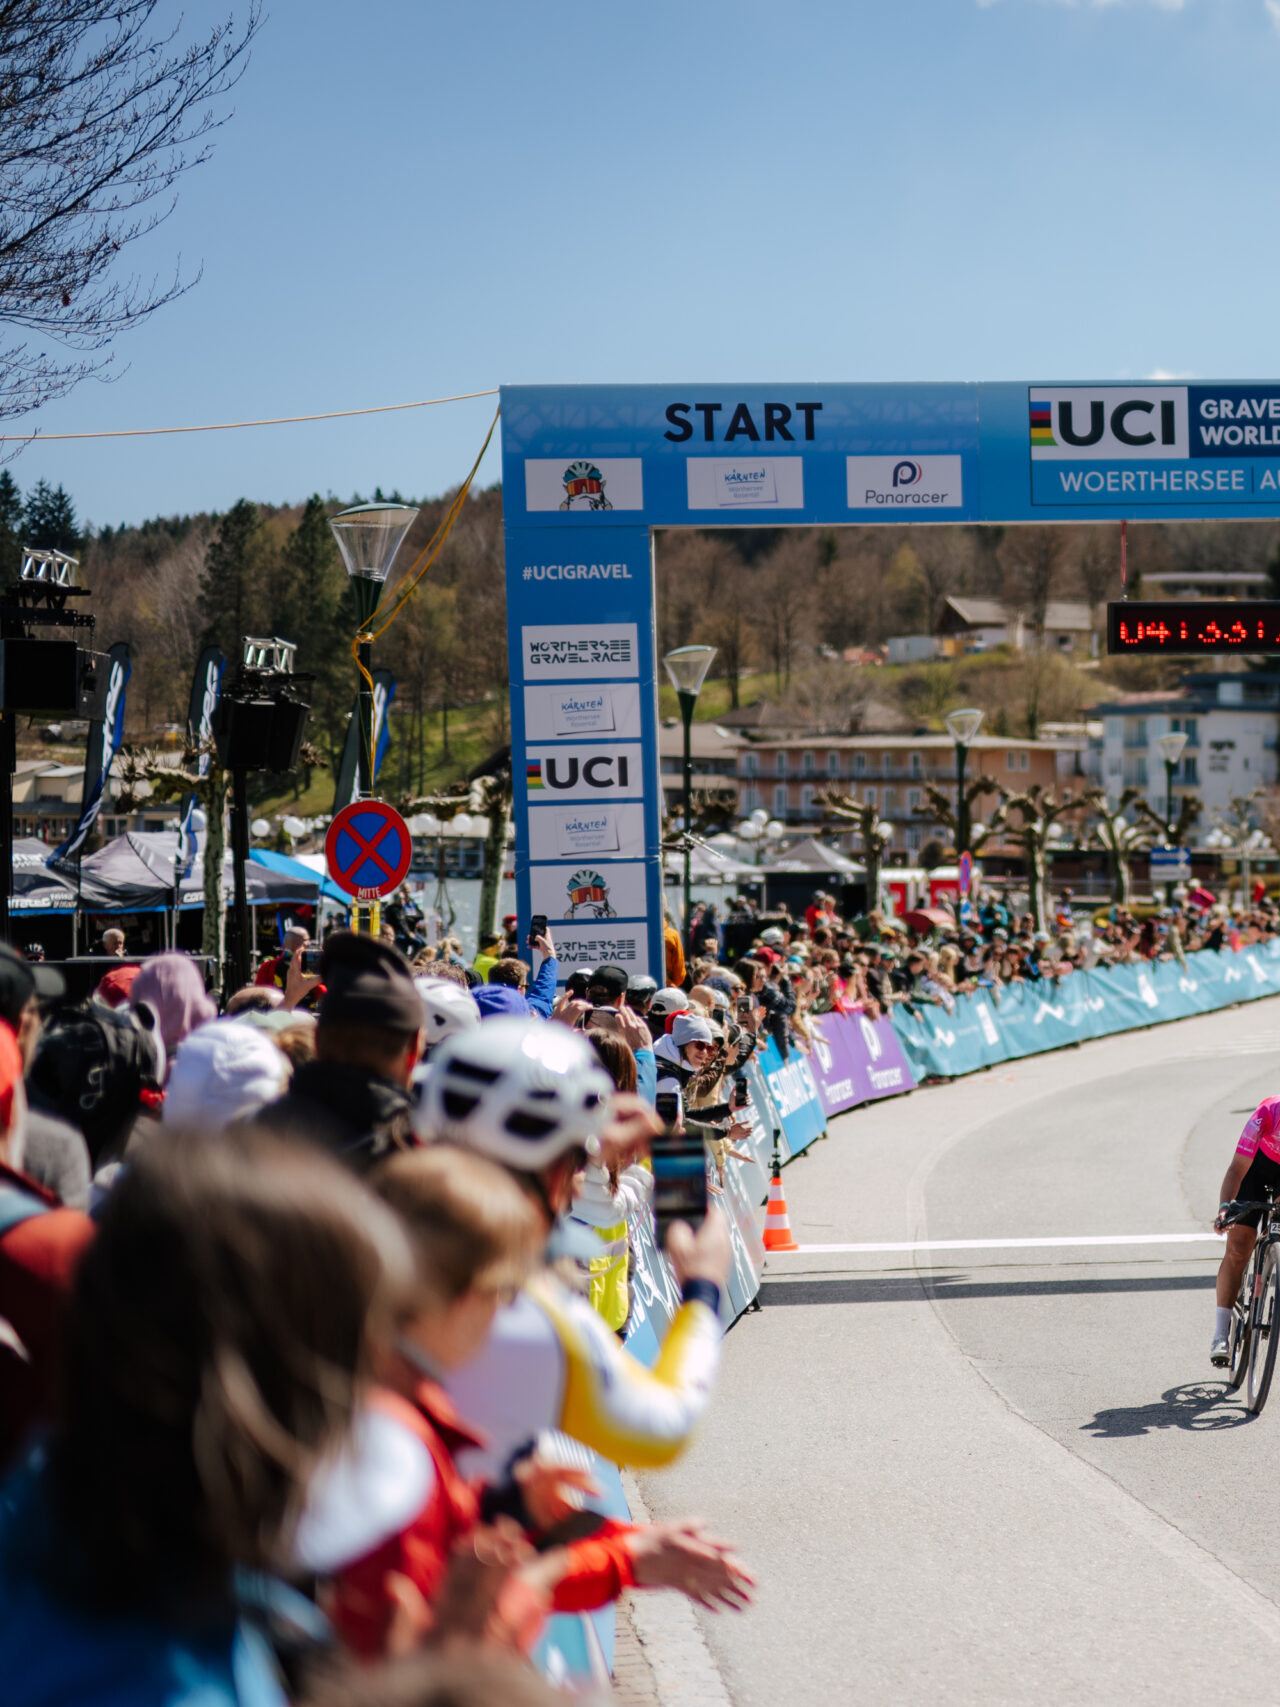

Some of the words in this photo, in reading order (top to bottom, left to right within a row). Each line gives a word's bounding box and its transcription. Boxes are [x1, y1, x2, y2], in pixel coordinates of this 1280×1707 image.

[663, 402, 823, 442] START
[1058, 400, 1176, 447] UCI
[1059, 469, 1245, 493] WOERTHERSEE
[865, 489, 948, 505] Panaracer
[522, 564, 632, 581] #UCIGRAVEL
[530, 652, 589, 665] GRAVEL
[590, 651, 631, 663] RACE
[545, 756, 628, 789] UCI
[358, 887, 381, 899] MITTE
[556, 952, 597, 962] RAVEL
[600, 950, 636, 960] RACE
